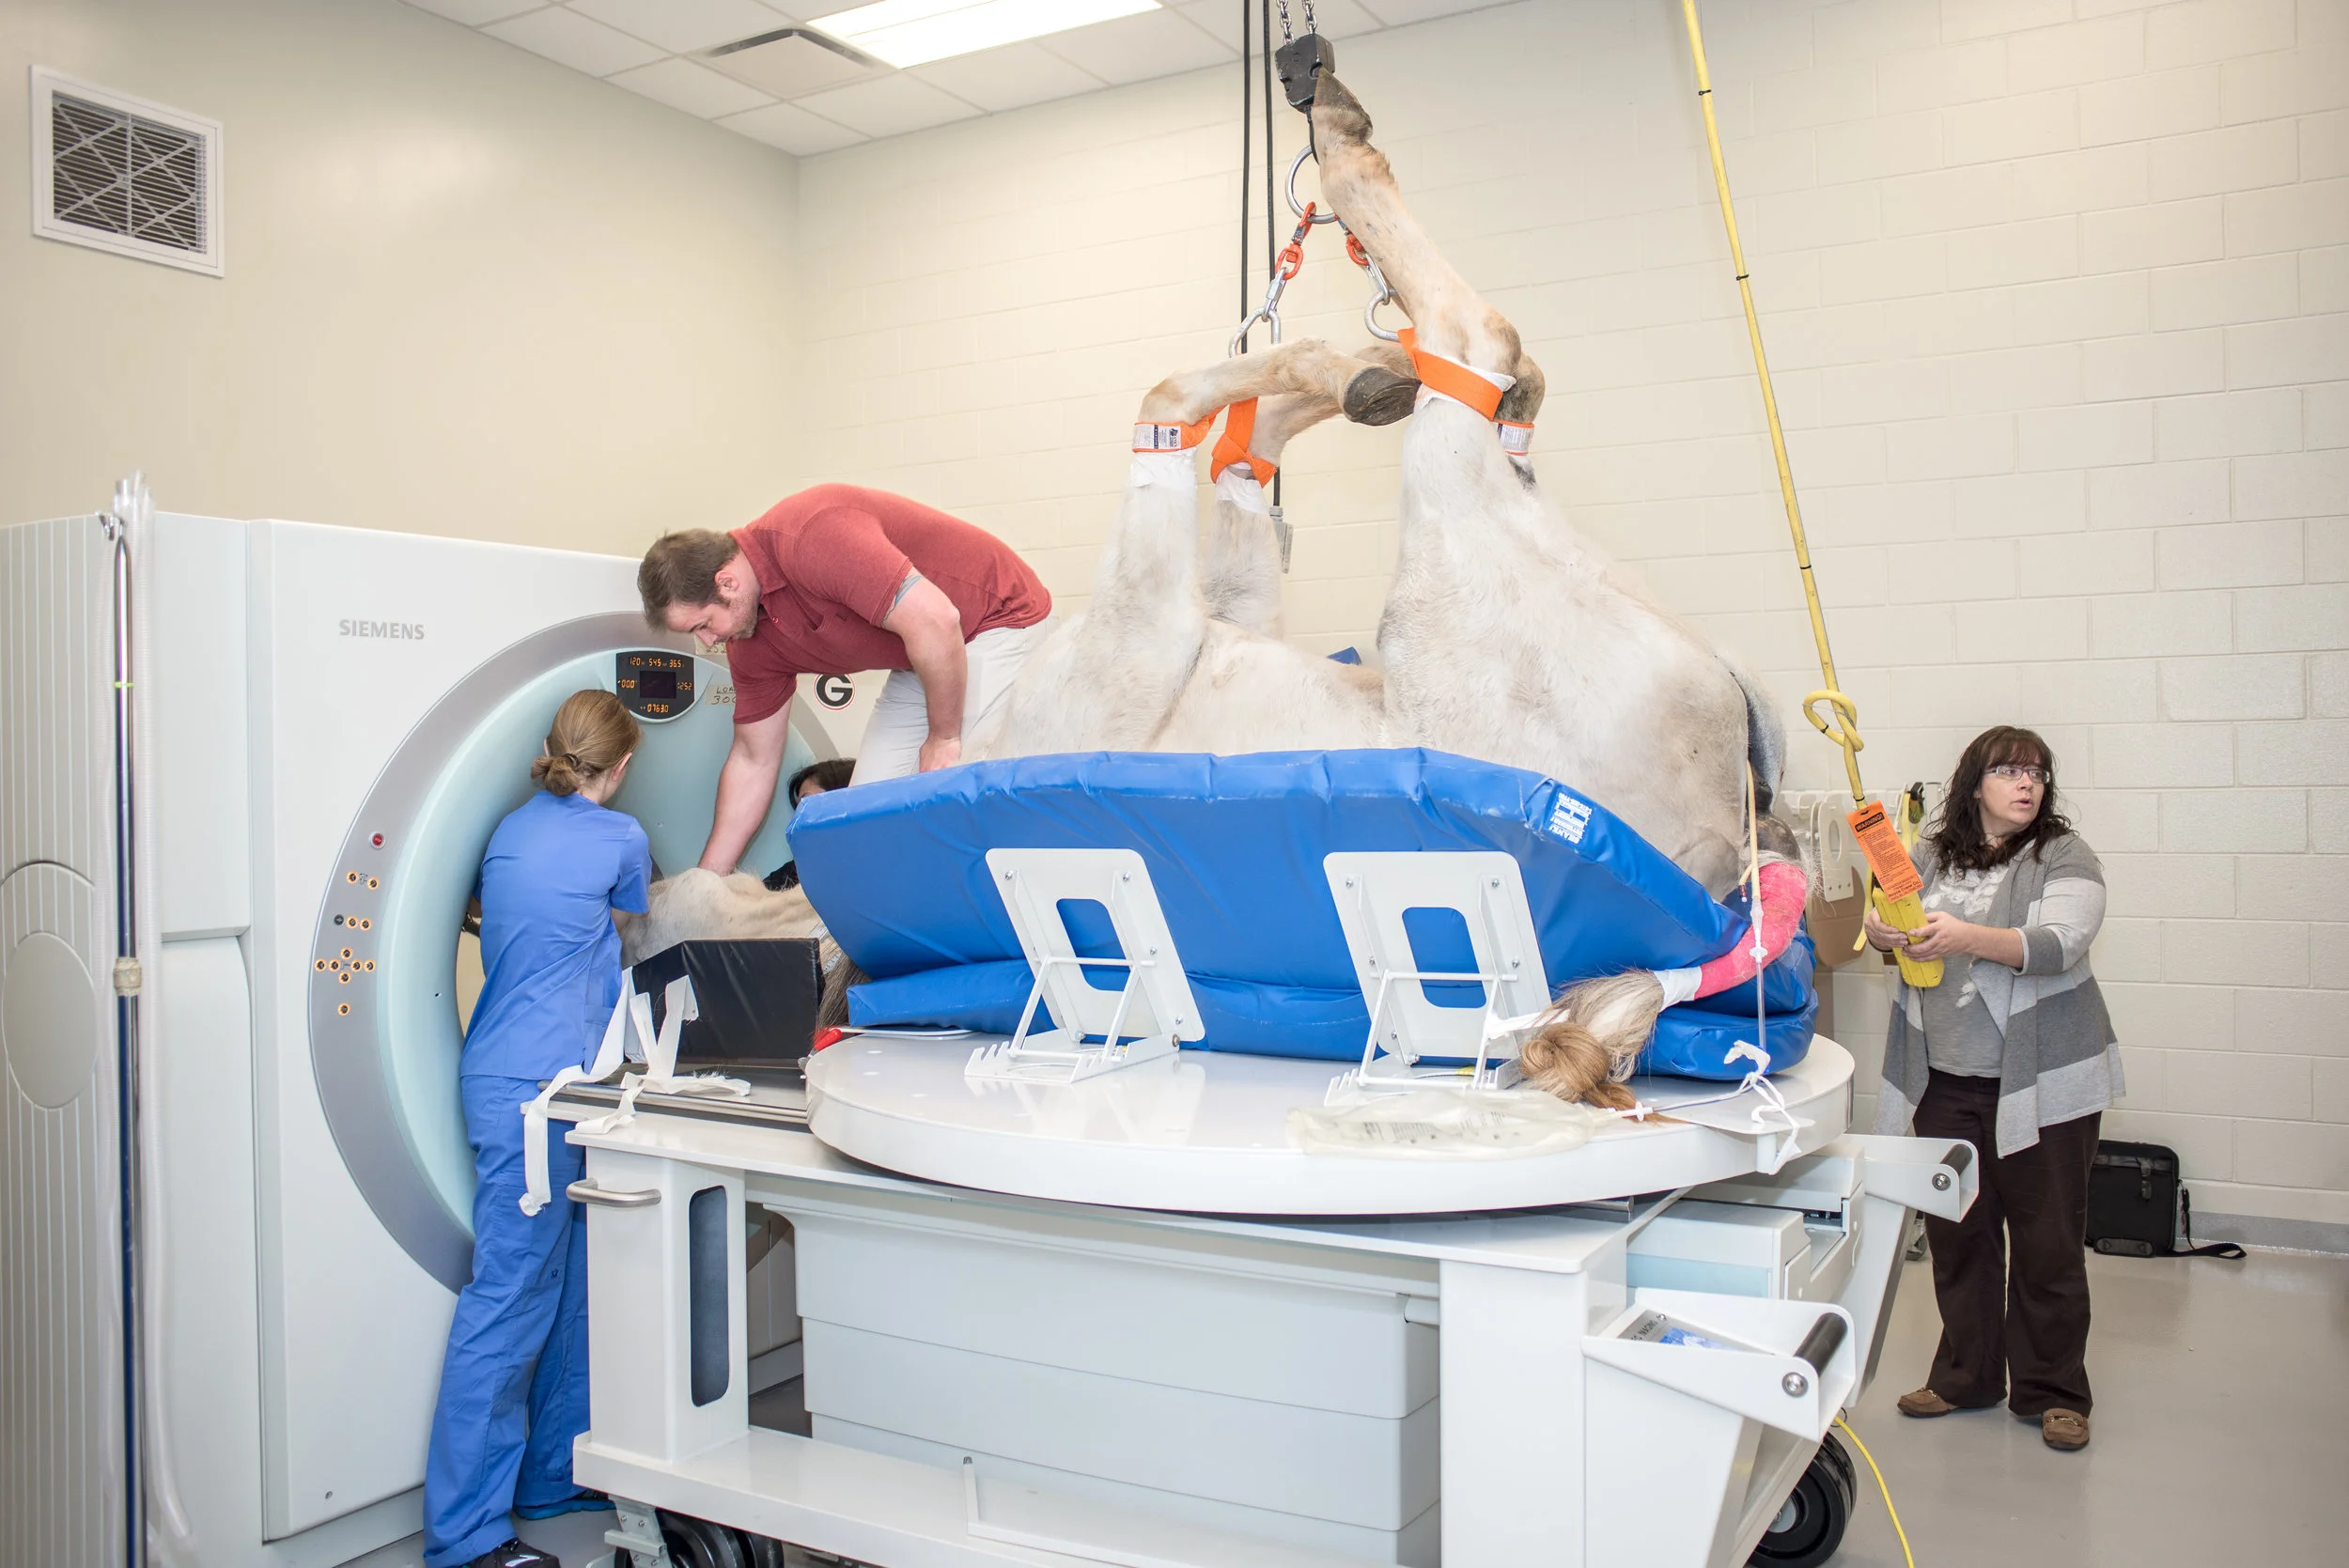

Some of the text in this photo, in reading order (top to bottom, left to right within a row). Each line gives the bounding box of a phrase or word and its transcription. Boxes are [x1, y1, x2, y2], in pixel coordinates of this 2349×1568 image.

[339, 619, 425, 640] SIEMENS
[630, 657, 641, 666] 120
[716, 686, 736, 694] LOA
[816, 674, 853, 706] G
[1856, 813, 1883, 831] WARNING!
